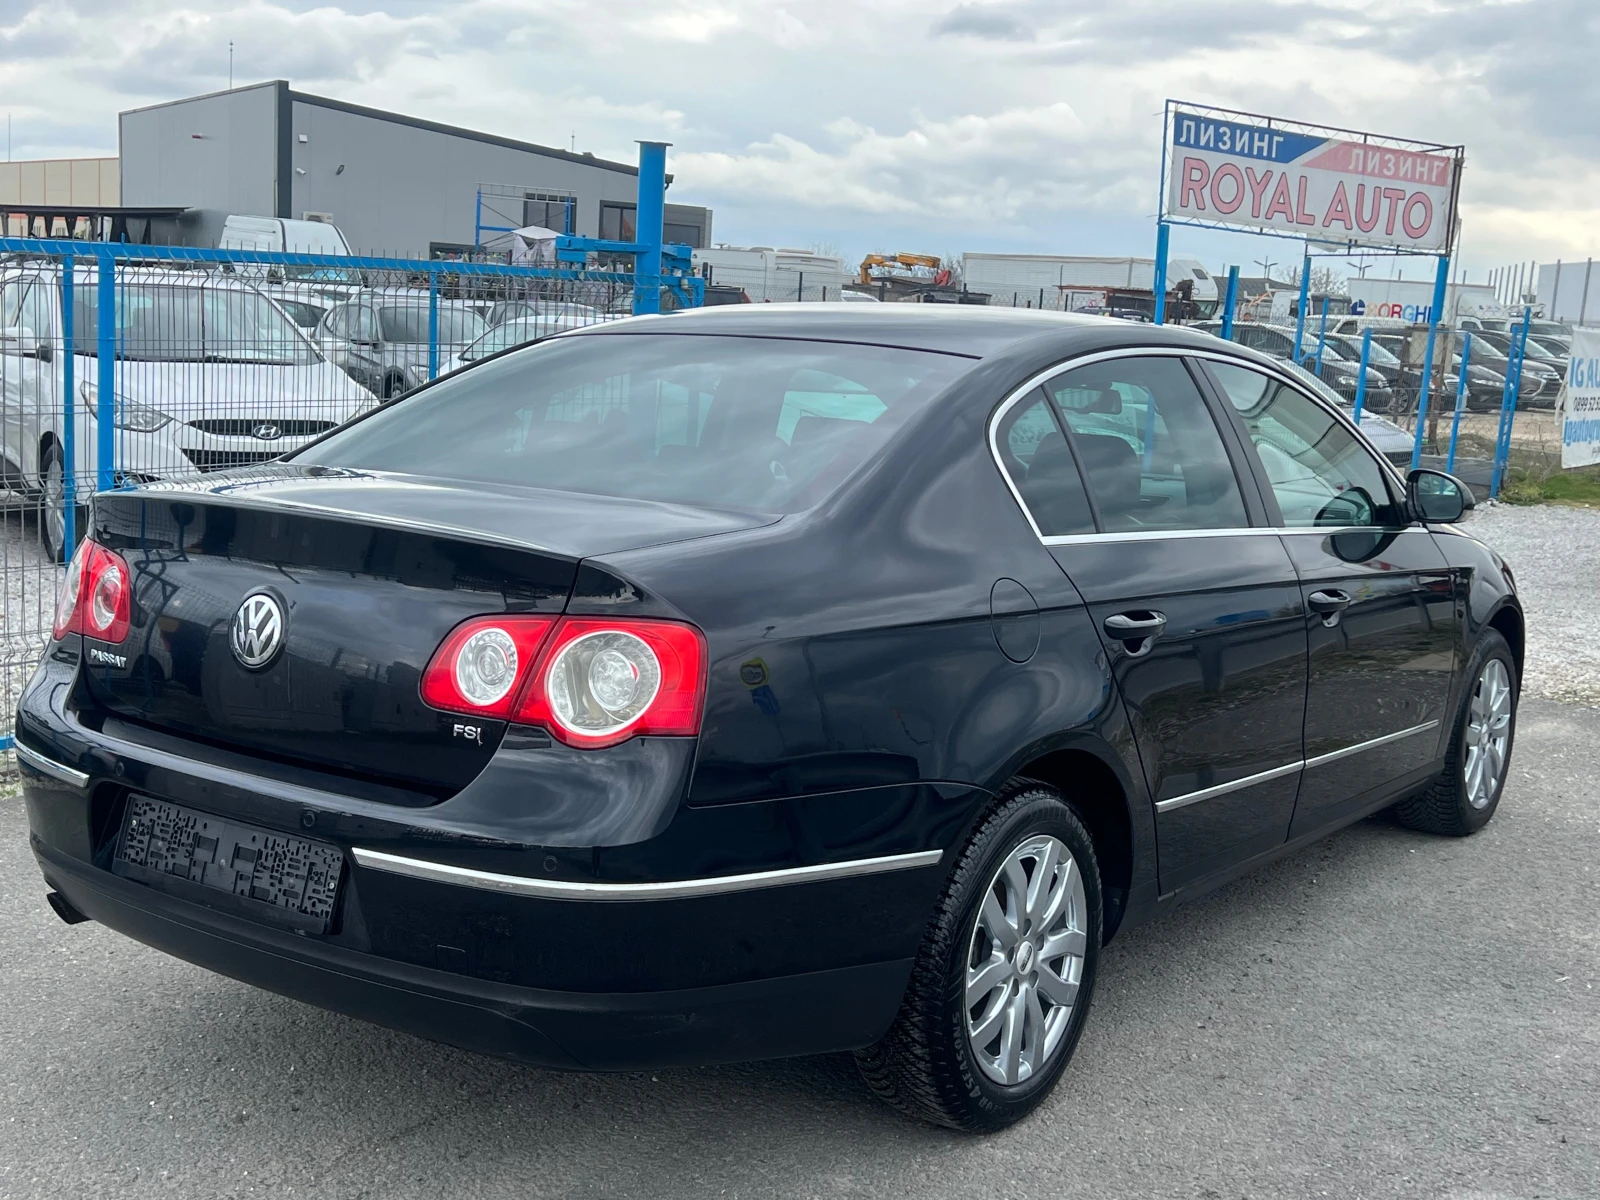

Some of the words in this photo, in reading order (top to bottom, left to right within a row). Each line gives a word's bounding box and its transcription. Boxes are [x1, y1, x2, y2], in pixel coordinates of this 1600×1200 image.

[1179, 119, 1284, 159] ЛИЗИНГ
[1348, 149, 1446, 182] ЛИЗИНГ
[1180, 156, 1316, 225] ROYAL
[1322, 180, 1433, 239] AUTO
[1569, 356, 1585, 388] IG
[90, 648, 126, 668] PASSAT
